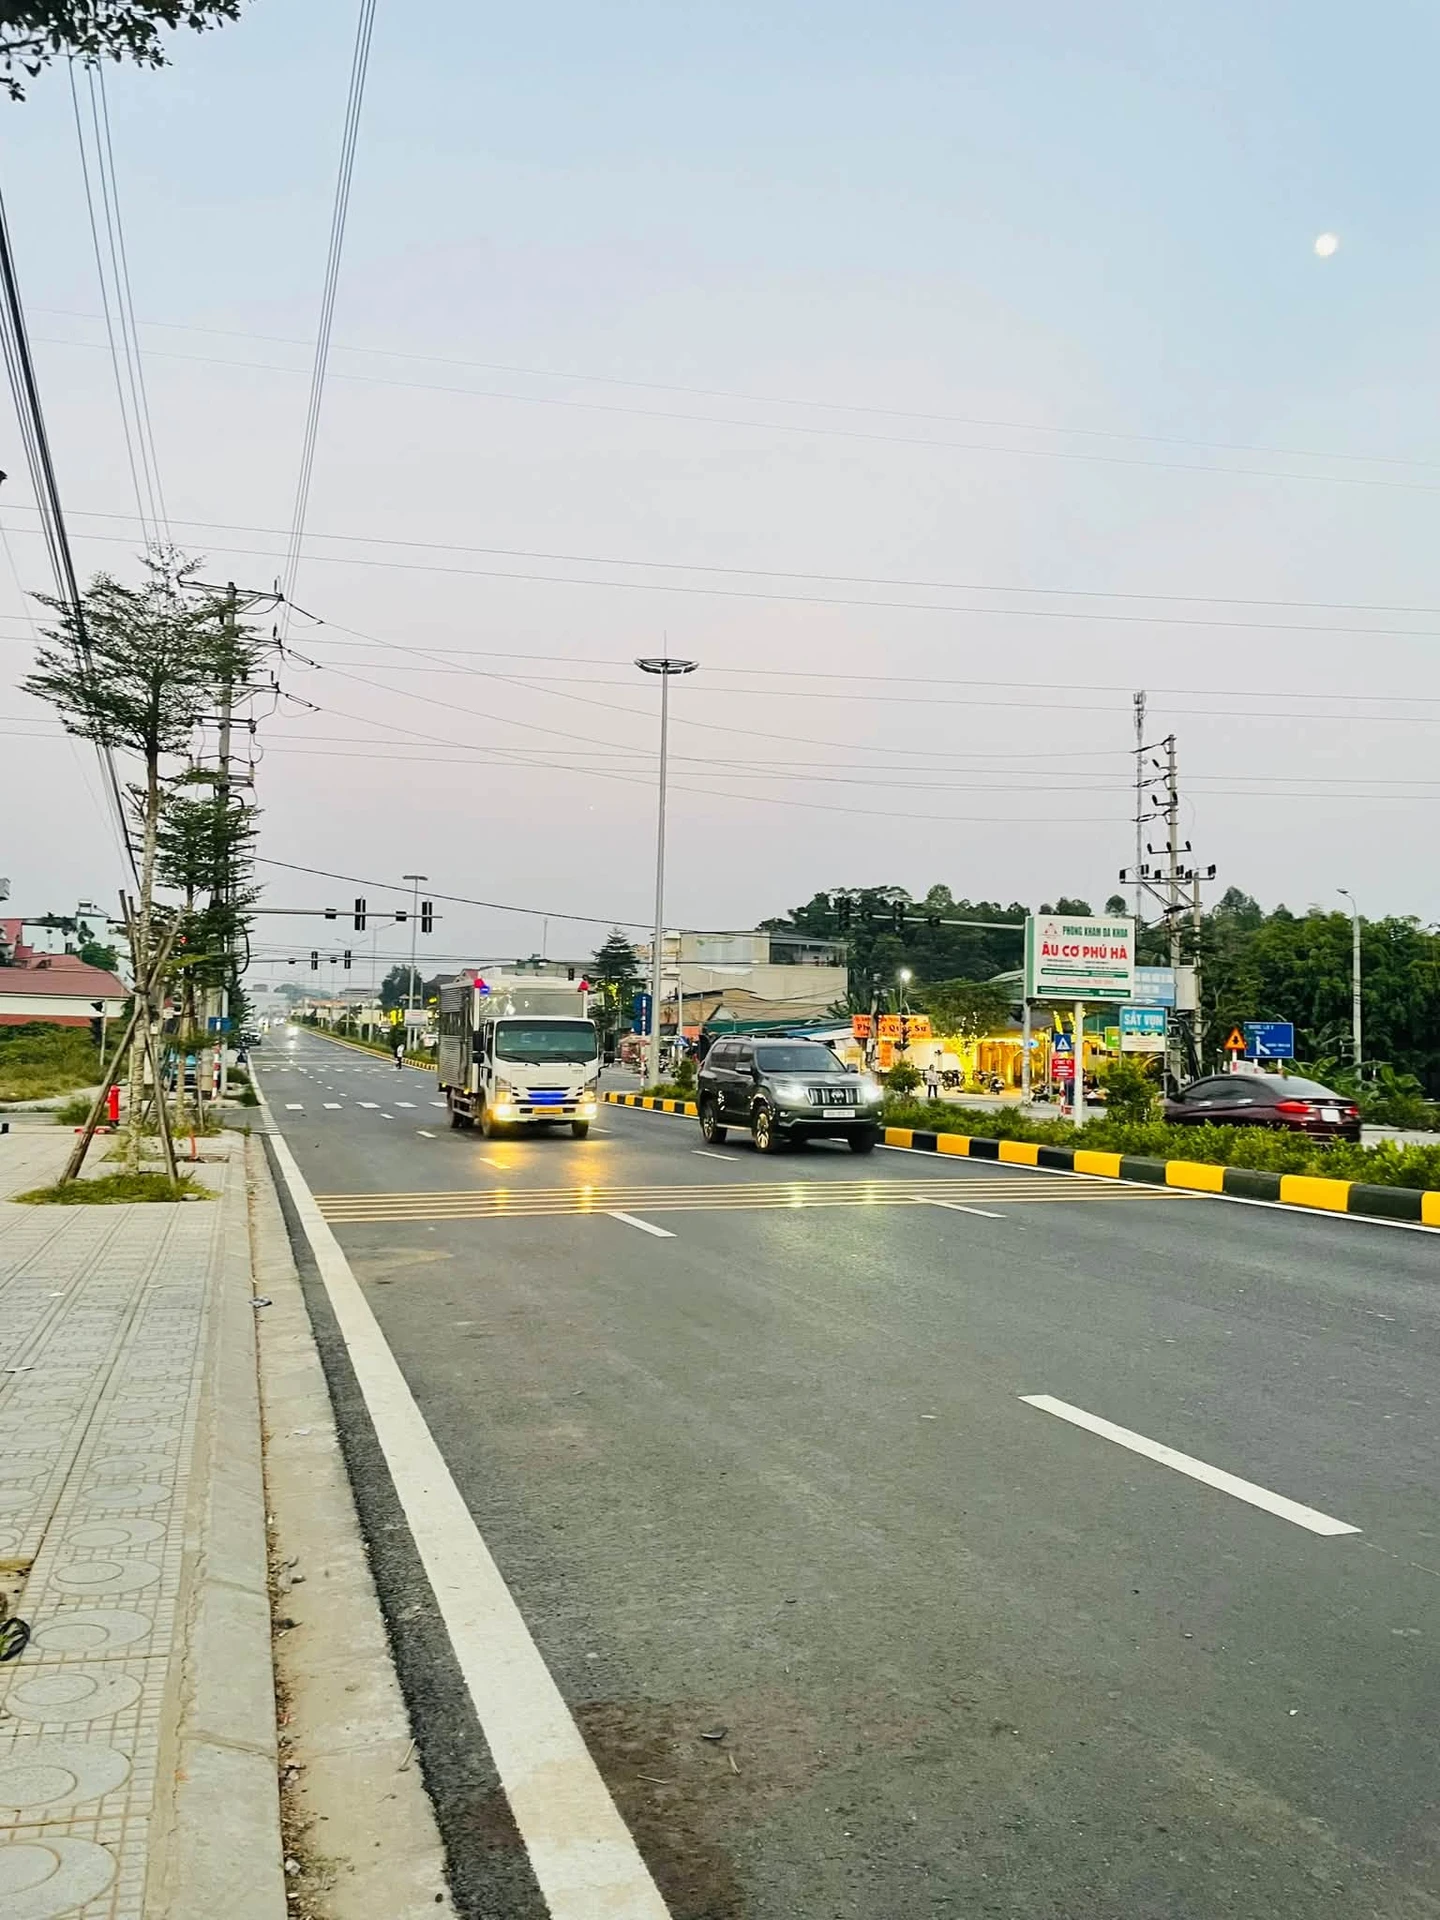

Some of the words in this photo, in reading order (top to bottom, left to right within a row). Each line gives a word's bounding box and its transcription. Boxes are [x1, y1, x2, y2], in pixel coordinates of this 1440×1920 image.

[1041, 941, 1059, 956] ÂU
[1061, 944, 1080, 957] CƠ
[1082, 944, 1107, 959] PHÚ
[1110, 944, 1128, 960] HÀ
